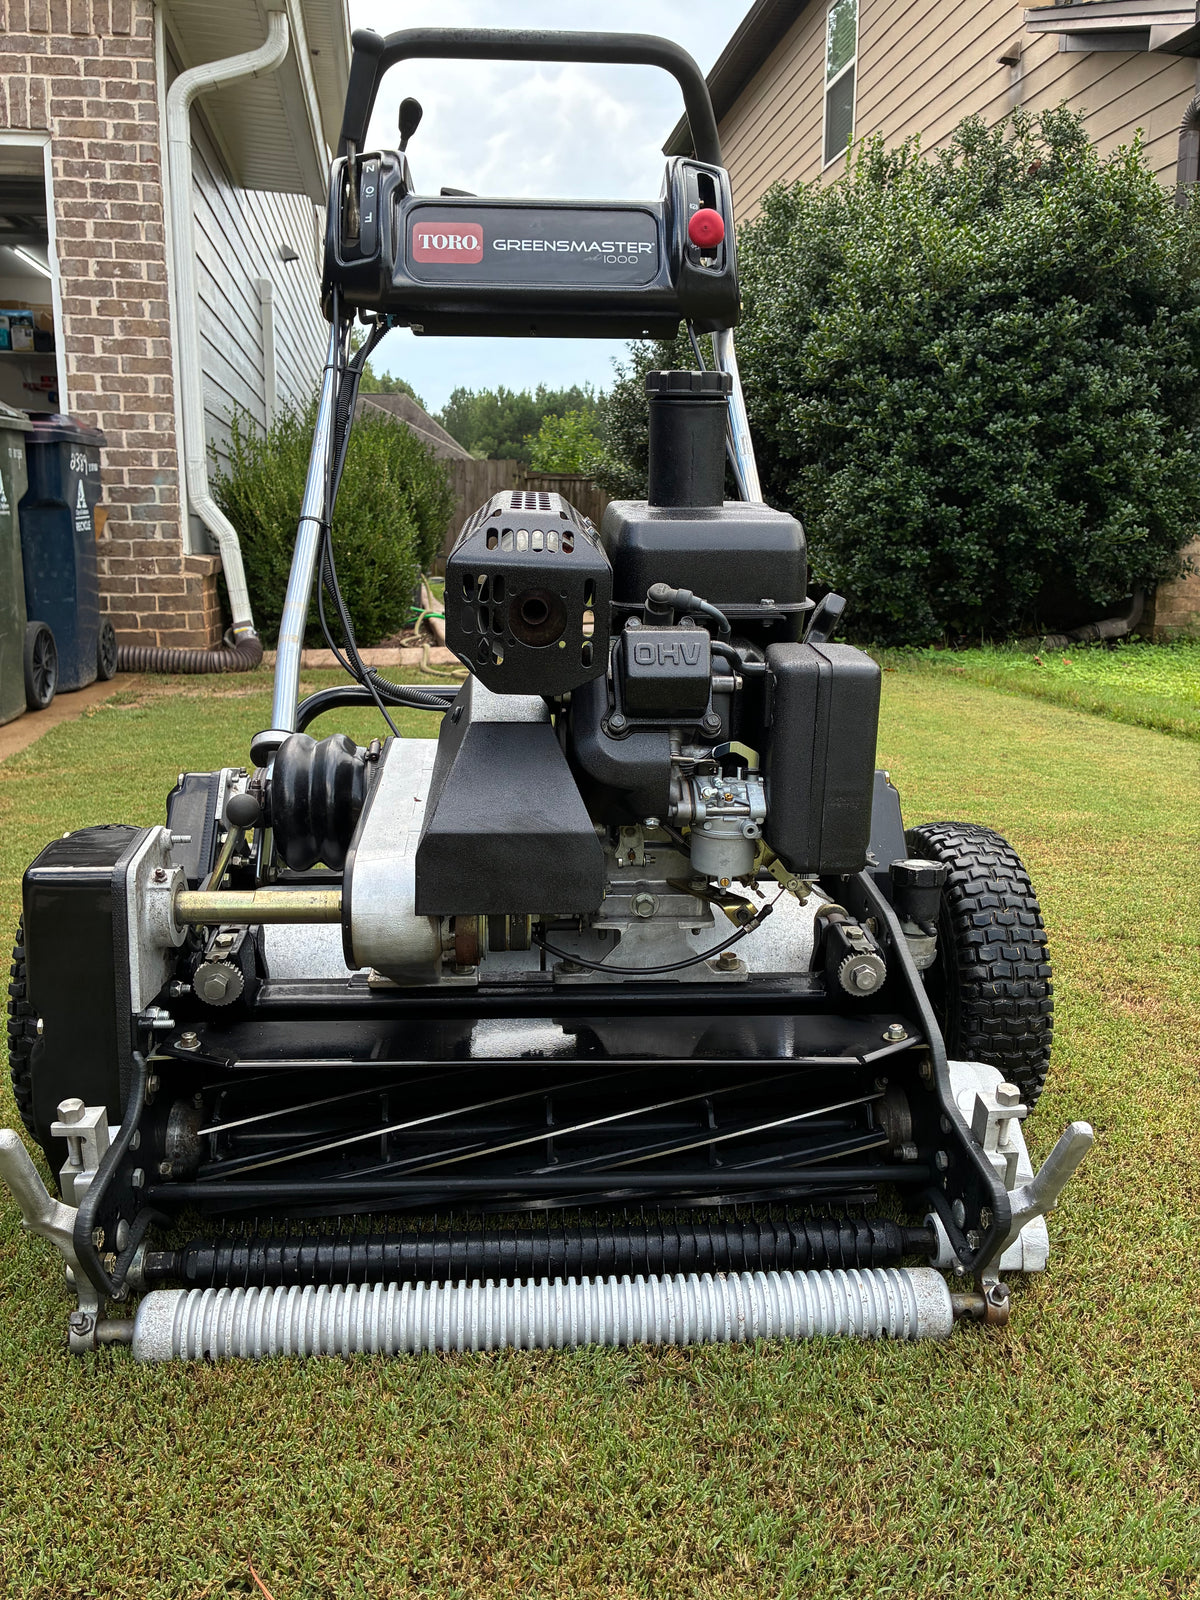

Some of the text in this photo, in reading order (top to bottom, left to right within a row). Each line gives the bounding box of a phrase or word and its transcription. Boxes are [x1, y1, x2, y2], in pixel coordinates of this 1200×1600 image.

[364, 212, 373, 223] F
[418, 234, 478, 250] TORO
[492, 239, 653, 254] GREENSMASTER
[603, 255, 638, 264] 1000
[634, 642, 700, 666] OHV
